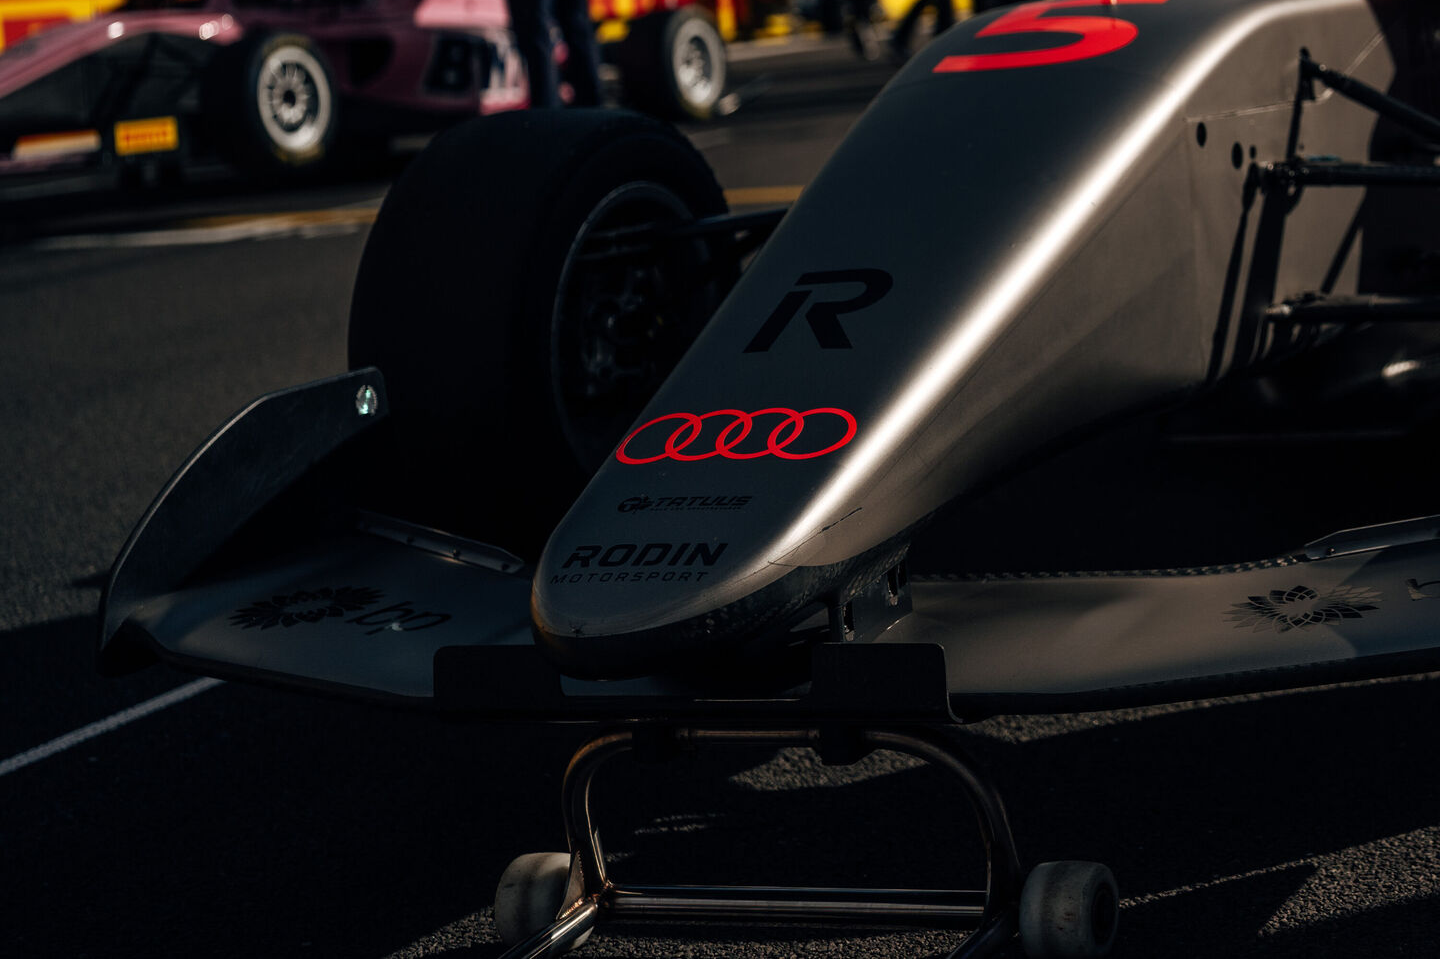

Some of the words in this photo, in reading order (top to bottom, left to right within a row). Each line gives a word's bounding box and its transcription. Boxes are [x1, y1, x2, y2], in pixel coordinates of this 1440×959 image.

[743, 268, 893, 353] R
[562, 543, 728, 568] RODIN
[550, 571, 709, 585] MOTORSPORT
[346, 601, 451, 636] bp
